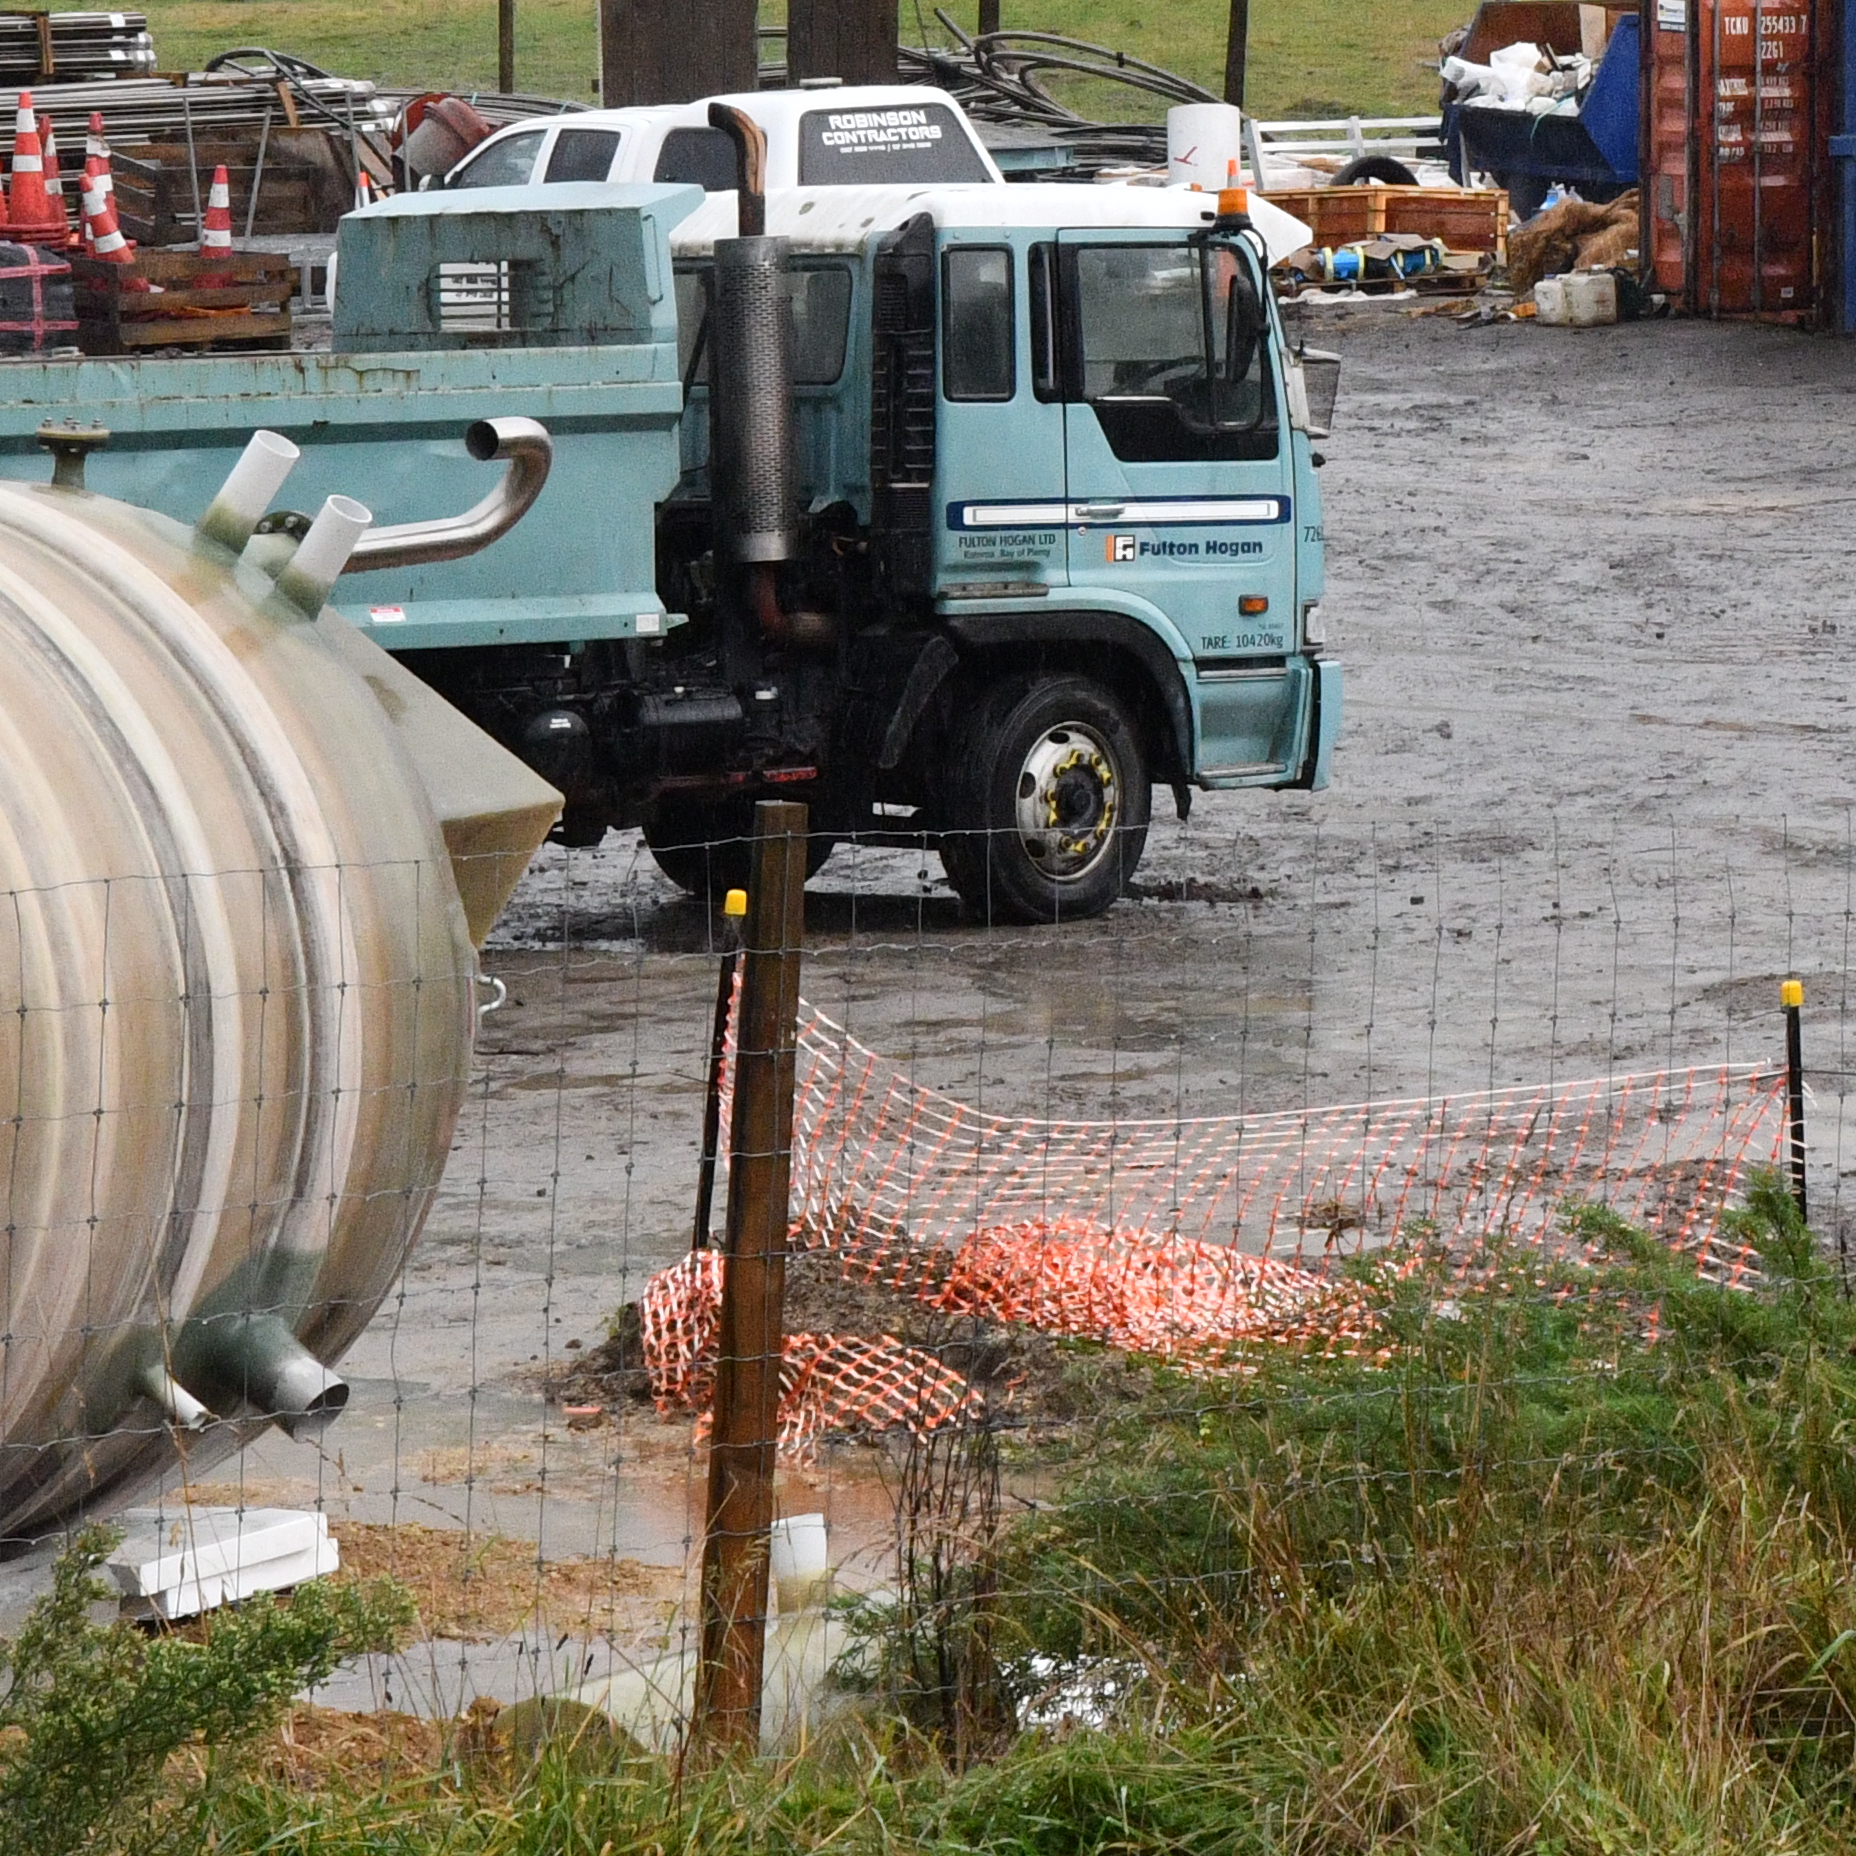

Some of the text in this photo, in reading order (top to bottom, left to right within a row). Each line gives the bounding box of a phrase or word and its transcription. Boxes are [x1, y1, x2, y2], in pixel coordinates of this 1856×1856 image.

[1725, 16, 1749, 35] TCKU
[1761, 16, 1796, 35] 255433
[828, 110, 927, 130] ROBINSON
[821, 125, 942, 145] CONTRACTORS
[958, 533, 1056, 549] FULTON HOGAN LTD
[1138, 541, 1199, 556] Fulton
[1205, 540, 1263, 557] Hogan
[1236, 633, 1284, 649] 10420kg
